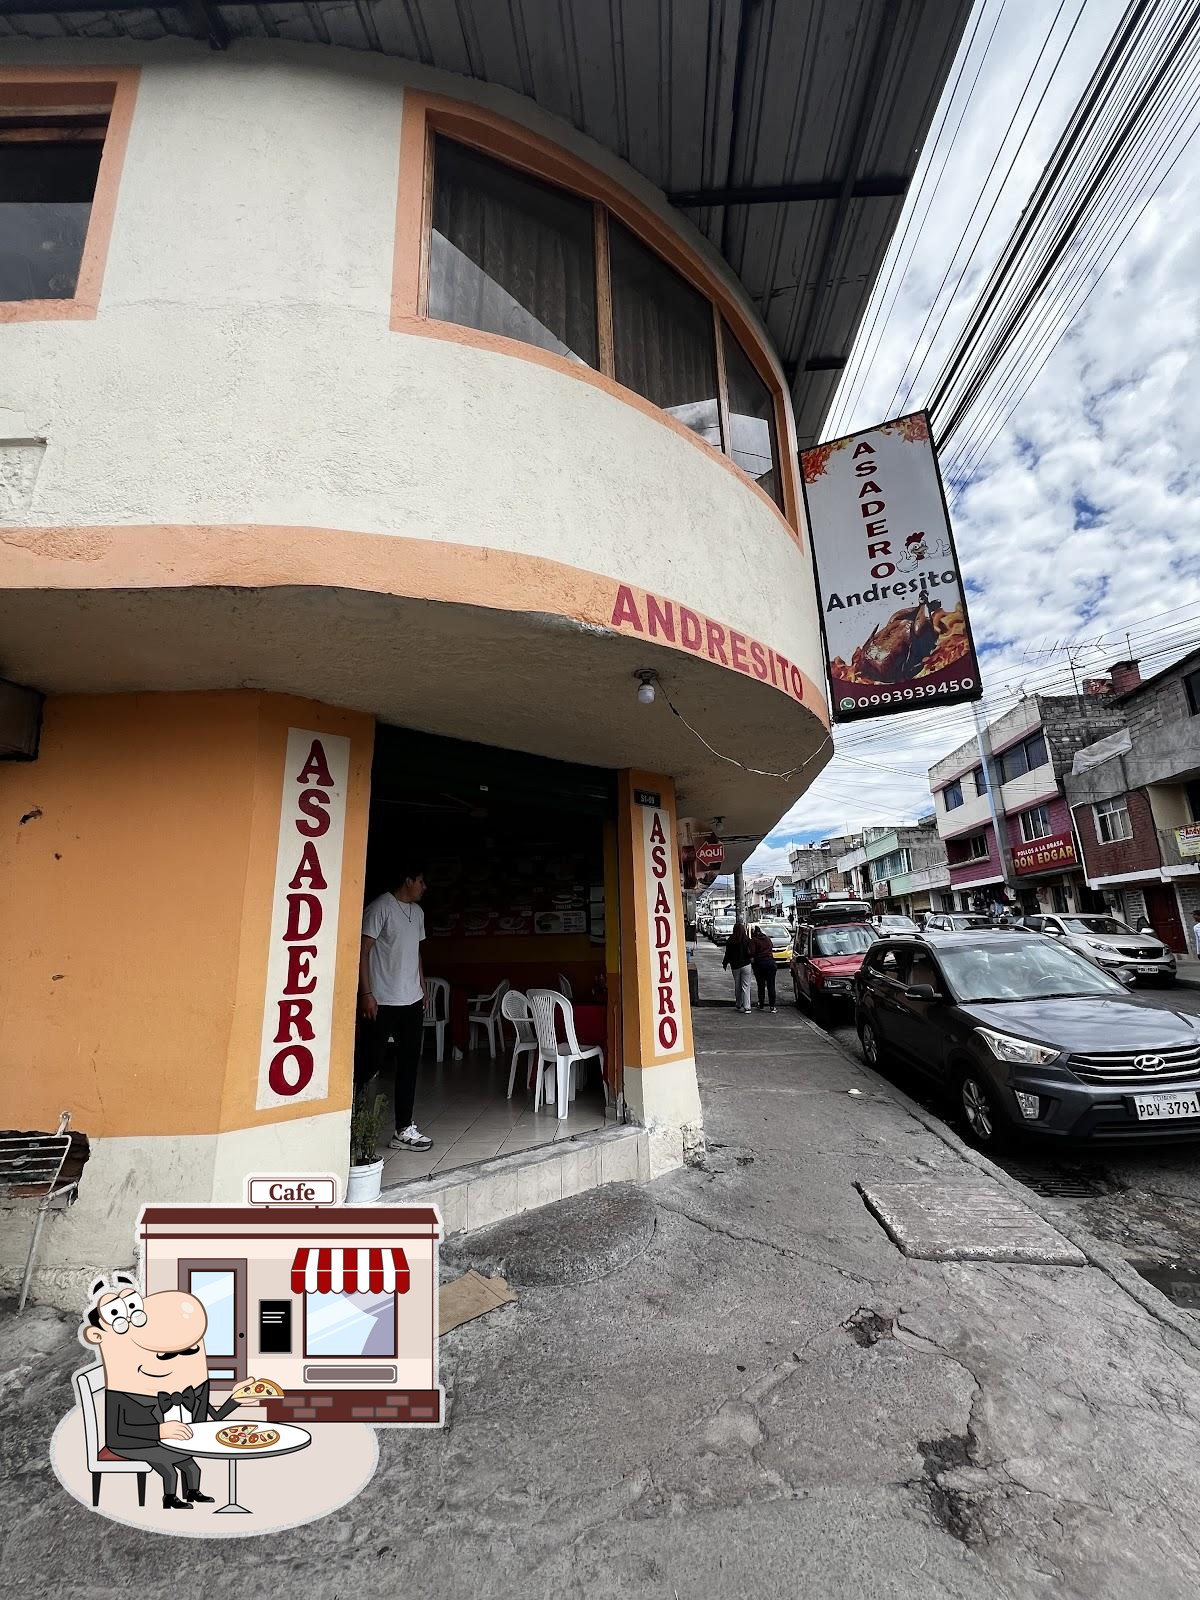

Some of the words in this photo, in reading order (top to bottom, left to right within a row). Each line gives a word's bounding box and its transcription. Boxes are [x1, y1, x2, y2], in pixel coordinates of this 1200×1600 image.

[852, 441, 896, 579] ASADERO
[826, 569, 958, 613] Andresito
[610, 584, 804, 701] ANDRESITO
[857, 677, 974, 709] 0993939450
[699, 846, 723, 858] AQUÍ
[1014, 855, 1034, 869] DON
[1037, 845, 1074, 864] EDGAR
[1017, 847, 1035, 857] POLLOS
[1046, 840, 1064, 850] BRASA
[268, 738, 335, 1097] ASADERO
[649, 812, 678, 1050] ASADERO
[1138, 1101, 1199, 1117] PCY-3791
